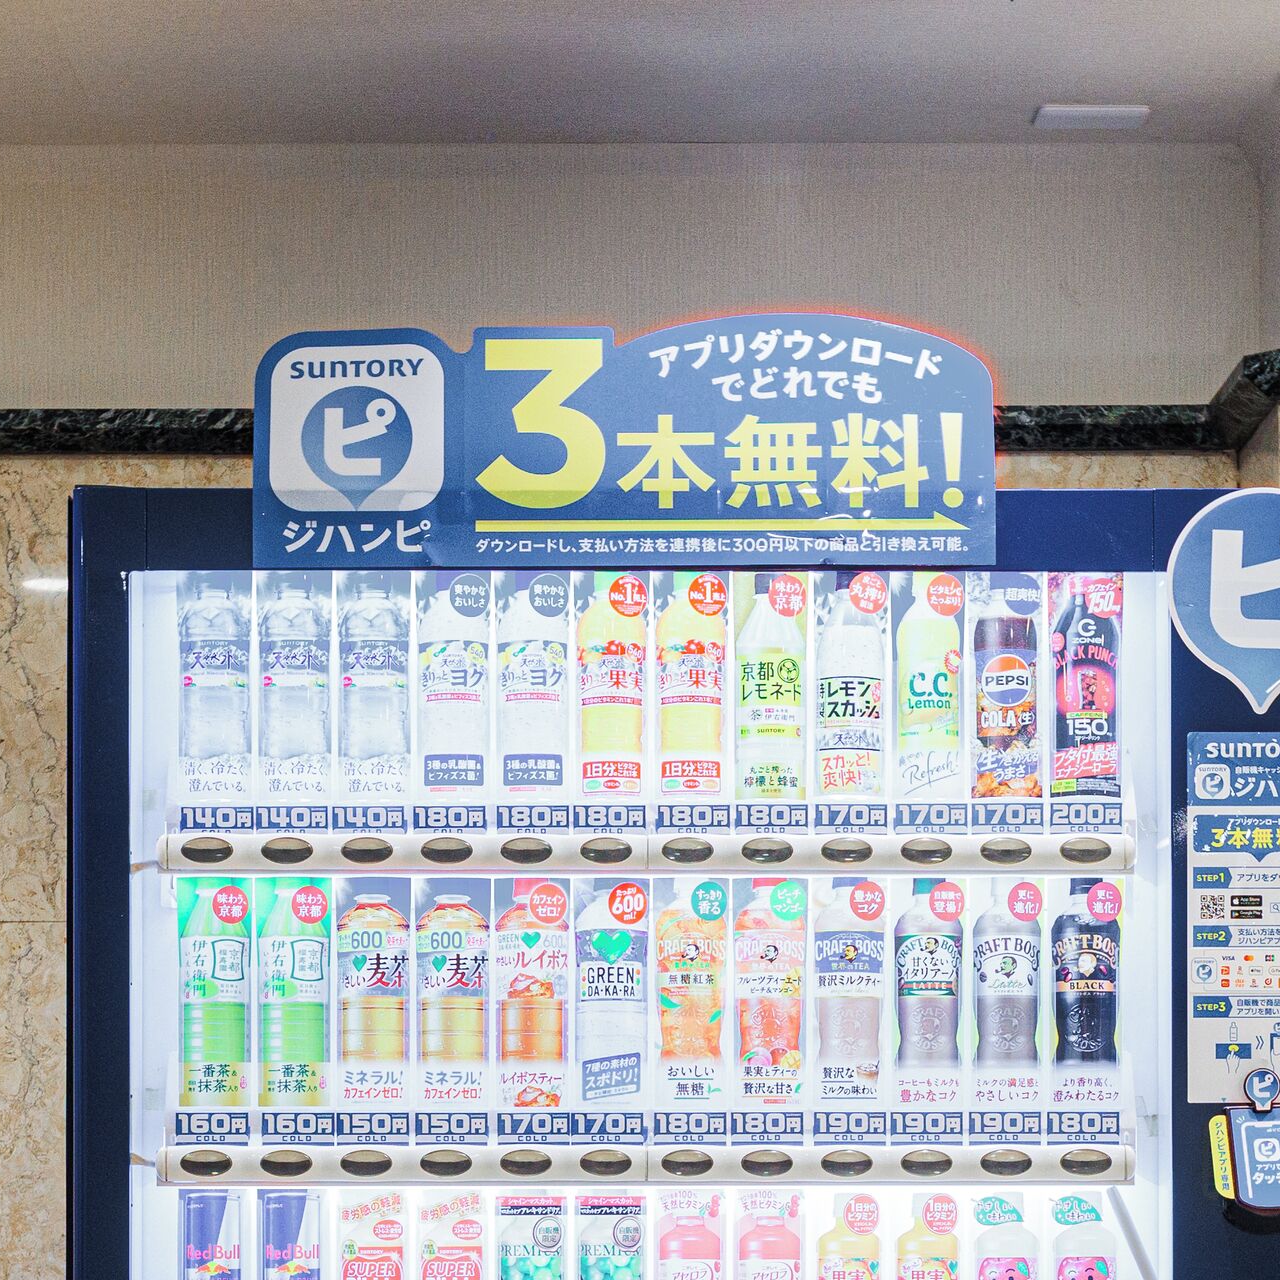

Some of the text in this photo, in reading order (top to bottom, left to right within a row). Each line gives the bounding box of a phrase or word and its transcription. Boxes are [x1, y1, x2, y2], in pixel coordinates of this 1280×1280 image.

[649, 328, 943, 379] アプリダウンロード
[290, 358, 424, 379] SUNTORY
[712, 366, 882, 404] でどれでも
[475, 338, 964, 509] 3本無料!
[324, 398, 396, 476] ピ
[282, 519, 431, 553] ジハンピ
[454, 584, 486, 595] 爽やかな
[454, 597, 486, 608] おいしさ
[190, 652, 239, 669] 天然水
[827, 681, 871, 698] レモン
[985, 675, 1029, 687] PEPSI
[742, 684, 801, 702] レモネード
[908, 698, 951, 709] Lemon
[981, 711, 1017, 729] COLA
[994, 765, 1026, 781] うまさ
[189, 779, 247, 793] 澄んでいる。
[183, 808, 253, 827] 140円
[259, 808, 327, 827] 140円
[334, 807, 404, 827] 140円
[415, 807, 484, 827] 180円
[499, 807, 567, 827] 180円
[575, 806, 644, 826] 180円
[660, 806, 728, 826] 180円
[737, 806, 806, 825] 180円
[818, 805, 885, 825] 170円
[900, 805, 963, 824] 170円
[975, 805, 1040, 824] 170円
[1053, 805, 1120, 824] 200円
[1196, 873, 1225, 882] STEP1
[696, 889, 722, 901] すっきり
[854, 891, 882, 902] 豊かな
[536, 906, 561, 917] ゼロ!
[612, 896, 644, 913] 600
[698, 901, 721, 915] 香る
[858, 903, 878, 913] コク
[1014, 901, 1039, 914] 進化!
[1196, 931, 1225, 940] STEP2
[912, 957, 949, 967] 甘くない
[587, 967, 635, 983] GREEN
[669, 974, 714, 985] 無糖紅茶
[913, 982, 947, 990] LATTE
[1069, 981, 1104, 990] BLACK
[1196, 1002, 1226, 1011] STEP3
[344, 1070, 403, 1085] ミネラル!
[667, 1066, 714, 1077] おいしい
[743, 1066, 797, 1078] 果実とティーの
[822, 1067, 854, 1079] 贅沢な
[344, 1087, 404, 1099] カフェインゼロ!
[676, 1082, 704, 1096] 無糖
[744, 1082, 792, 1095] 贅沢な甘さ
[822, 1085, 877, 1096] ミルクの味わい
[900, 1089, 956, 1102] 豊かなコク
[975, 1089, 1039, 1101] やさしいコク
[1053, 1090, 1119, 1102] 澄みわたるコク
[178, 1114, 246, 1134] 160円
[264, 1114, 332, 1134] 160円
[340, 1114, 407, 1134] 150円
[419, 1114, 485, 1134] 150円
[501, 1114, 568, 1133] 170円
[575, 1114, 640, 1133] 170円
[657, 1114, 724, 1133] 180円
[733, 1114, 800, 1133] 180円
[816, 1113, 884, 1132] 190円
[893, 1113, 960, 1132] 190円
[971, 1113, 1039, 1132] 190円
[1050, 1113, 1117, 1132] 180円
[349, 1262, 395, 1277] SUPER
